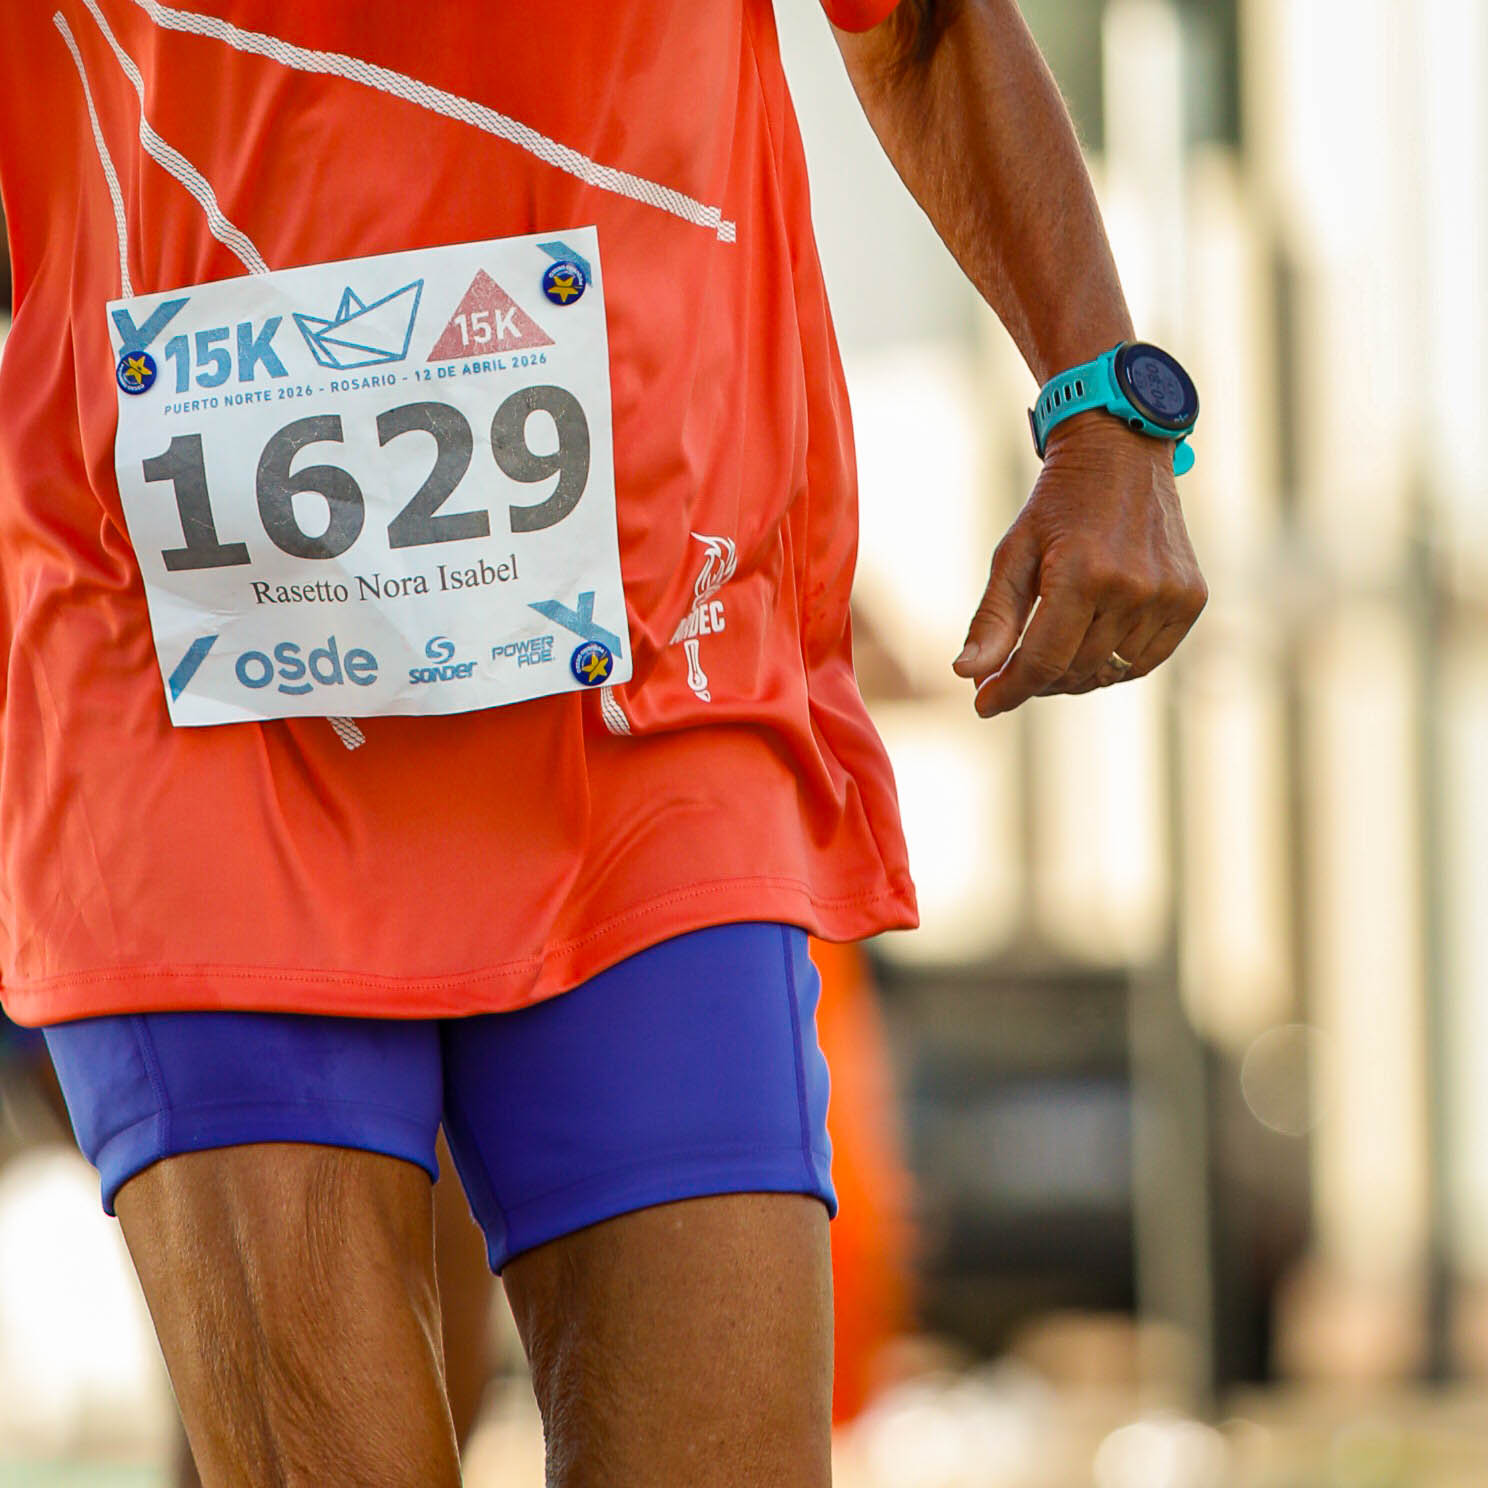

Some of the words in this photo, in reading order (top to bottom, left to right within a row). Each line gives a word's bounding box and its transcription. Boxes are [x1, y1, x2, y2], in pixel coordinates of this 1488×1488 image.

[164, 315, 290, 394] 15K
[453, 306, 523, 348] 15K
[164, 397, 219, 415] PUERTO
[224, 390, 272, 407] NORTE
[278, 384, 313, 400] 2026
[330, 373, 397, 393] ROSARIO
[415, 369, 432, 382] 12
[438, 365, 457, 379] DE
[462, 356, 507, 375] ABRIL
[511, 352, 548, 368] 2026
[141, 384, 592, 572] 1629
[249, 580, 349, 605] Rasetto
[353, 572, 429, 602] Nora
[436, 553, 520, 592] Isabel
[235, 634, 379, 695] osde
[491, 635, 554, 661] POWER
